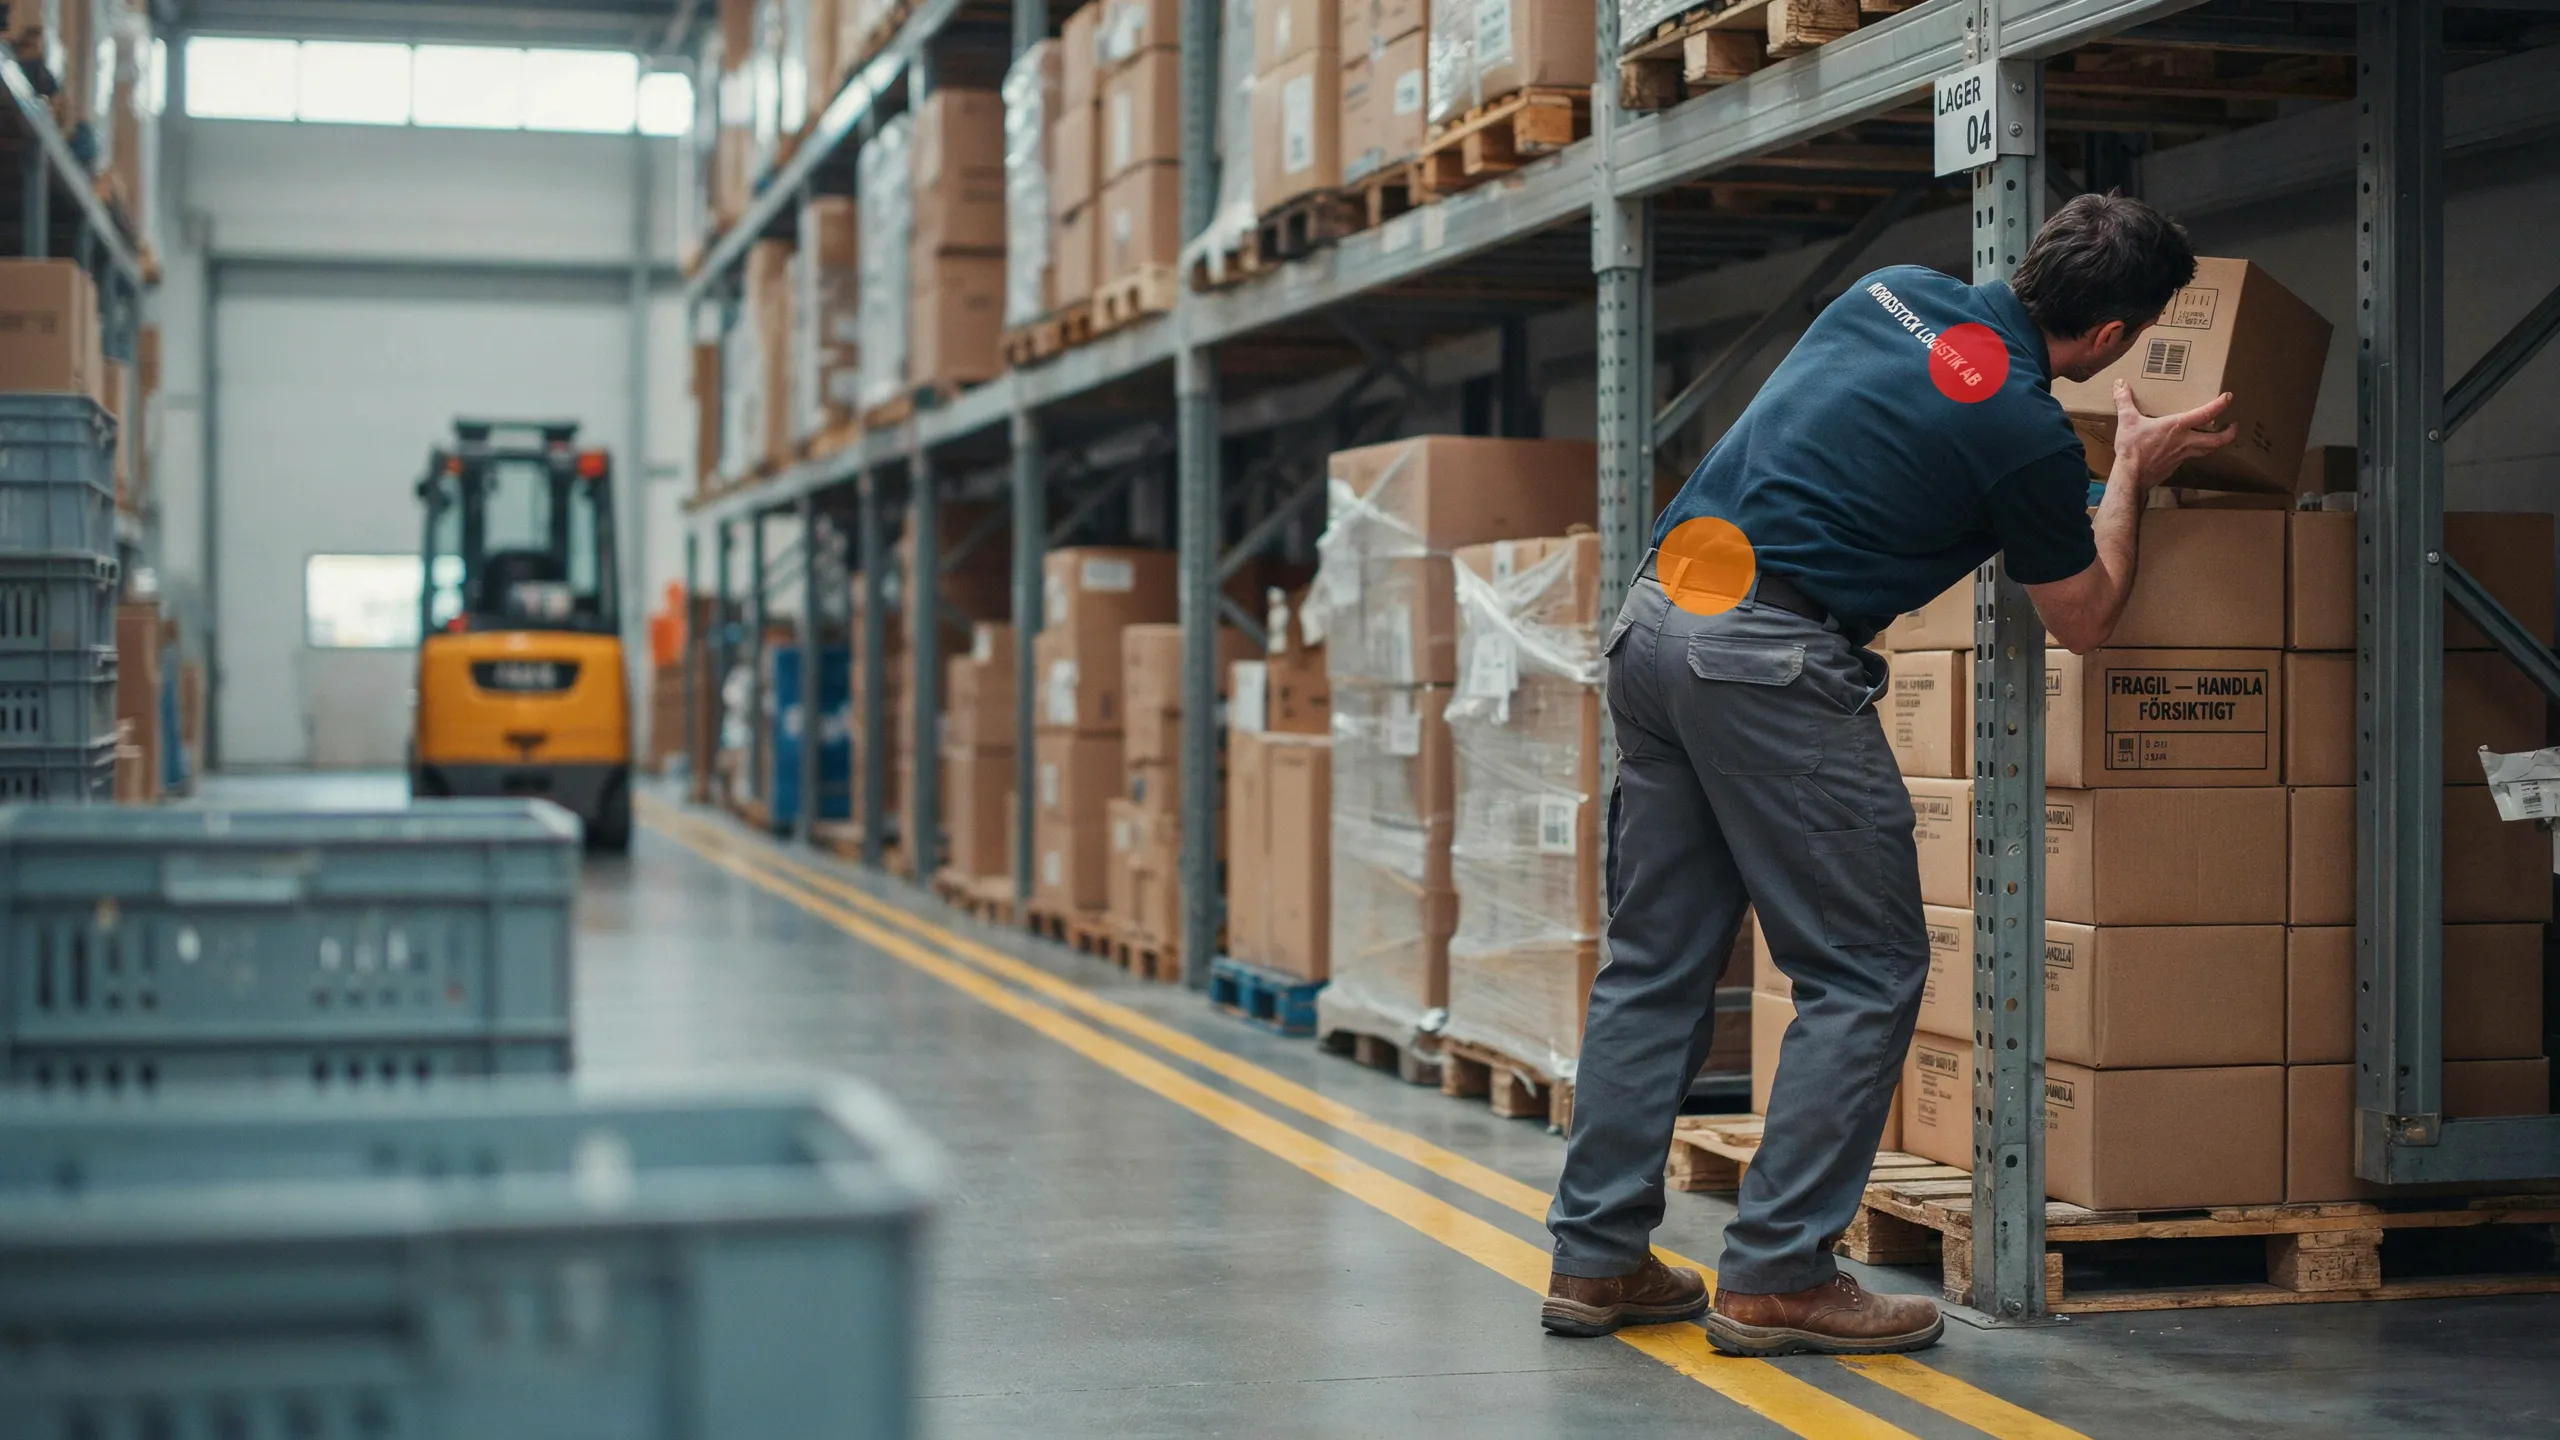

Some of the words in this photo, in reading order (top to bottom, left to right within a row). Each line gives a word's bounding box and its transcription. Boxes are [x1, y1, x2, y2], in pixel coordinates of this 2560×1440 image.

[1938, 76, 1981, 116] LAGER
[1967, 109, 1991, 155] 04
[1915, 328, 1968, 370] LOGISTIK
[1959, 367, 1982, 386] AB
[2111, 676, 2171, 695] FRAGIL
[2197, 676, 2263, 696] HANDLA
[2139, 697, 2236, 721] FÖRSIKTIGT
